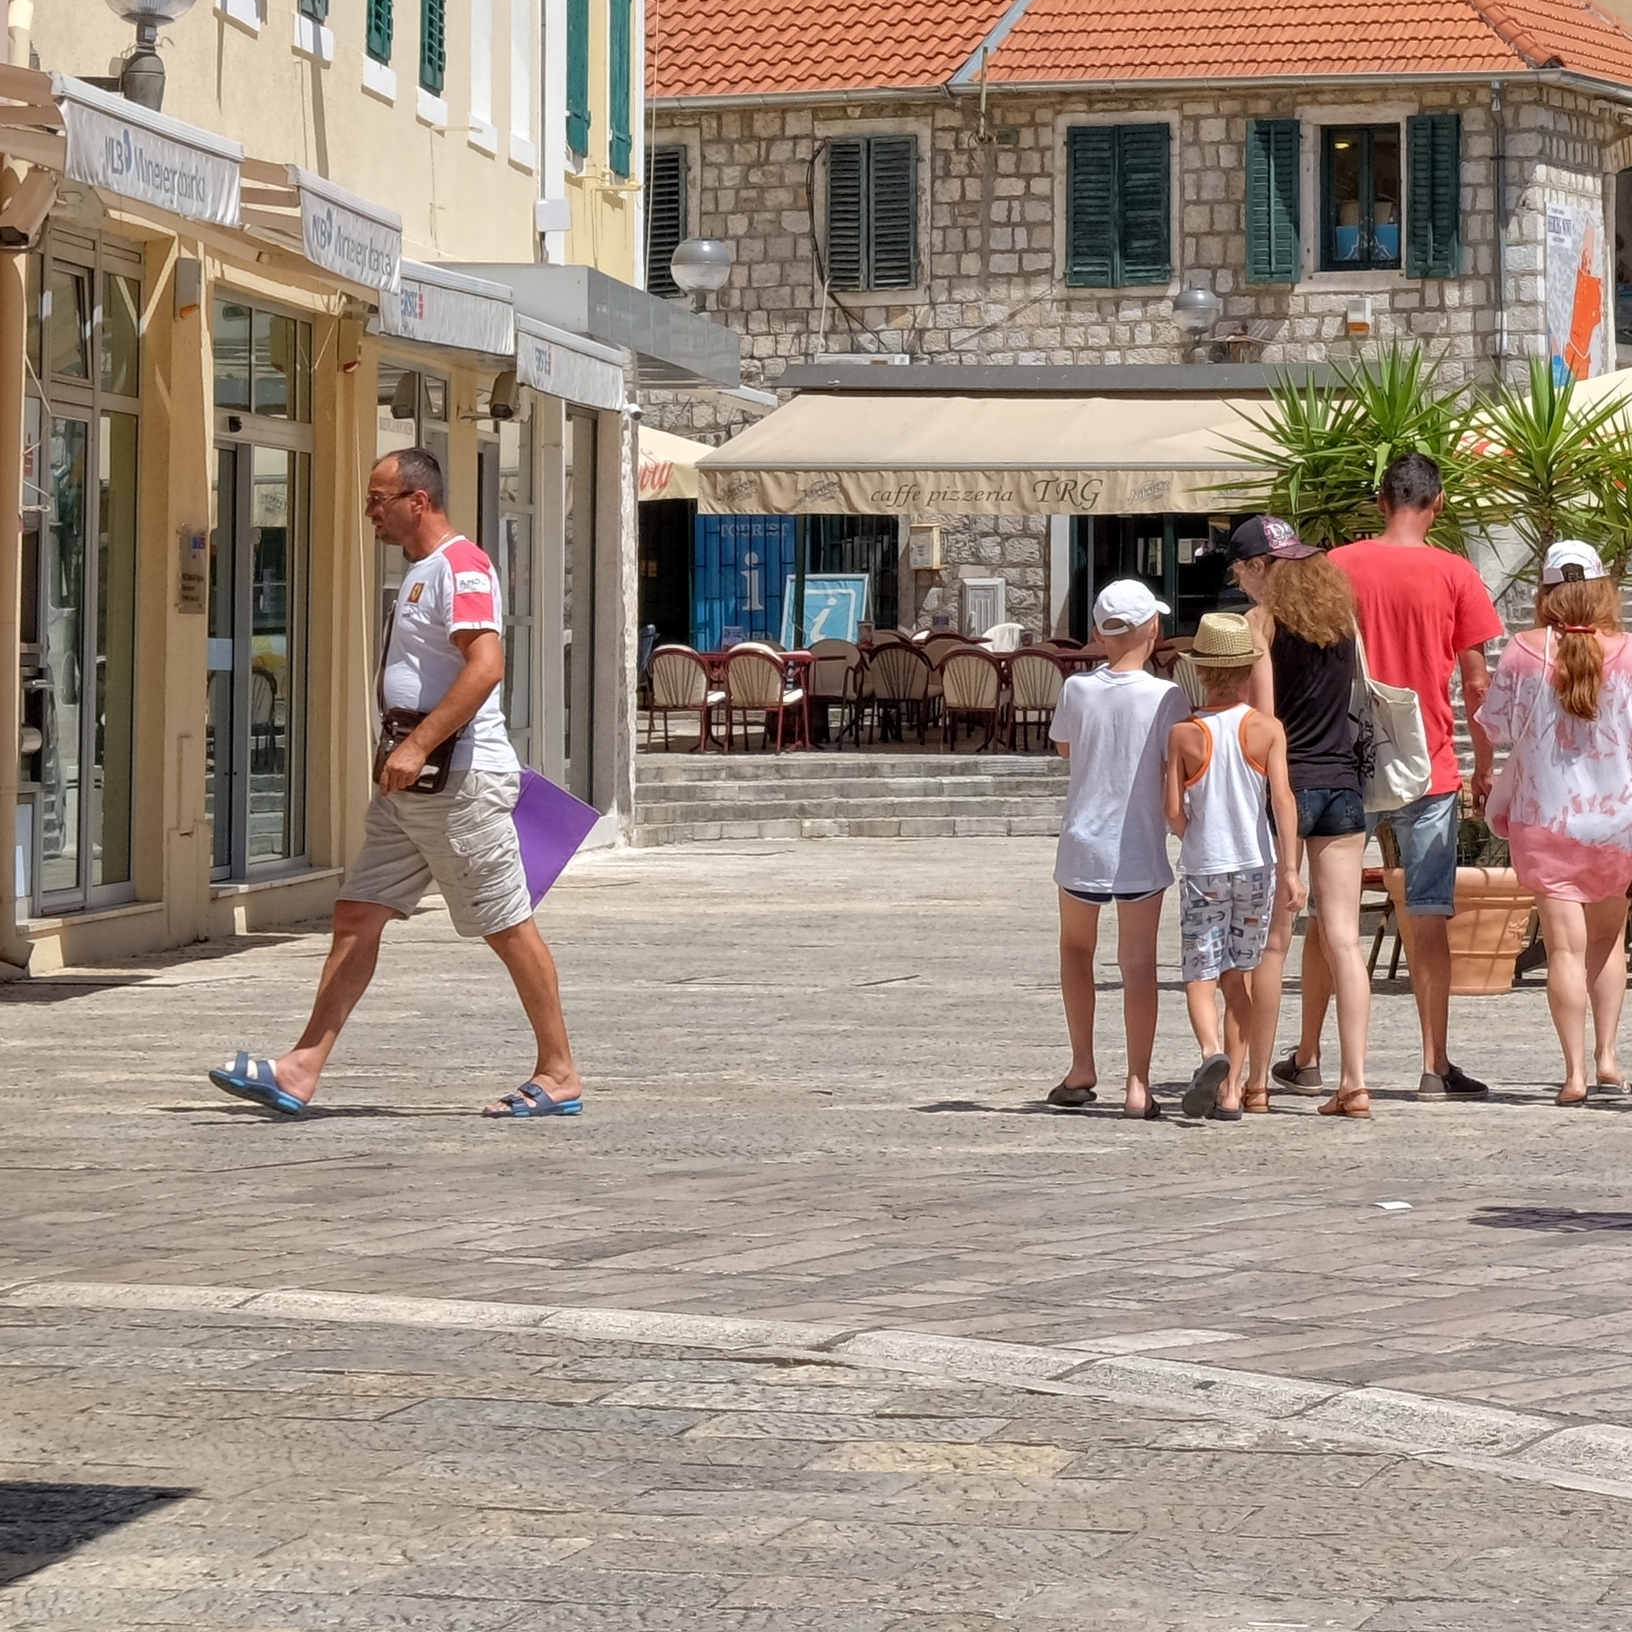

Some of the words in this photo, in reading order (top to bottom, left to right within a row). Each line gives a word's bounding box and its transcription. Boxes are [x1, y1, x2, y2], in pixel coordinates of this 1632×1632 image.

[312, 214, 327, 251] NB
[870, 484, 922, 508] caffe
[926, 485, 1014, 507] pizzeria
[1033, 478, 1104, 511] TRG
[718, 523, 790, 538] TOURIST
